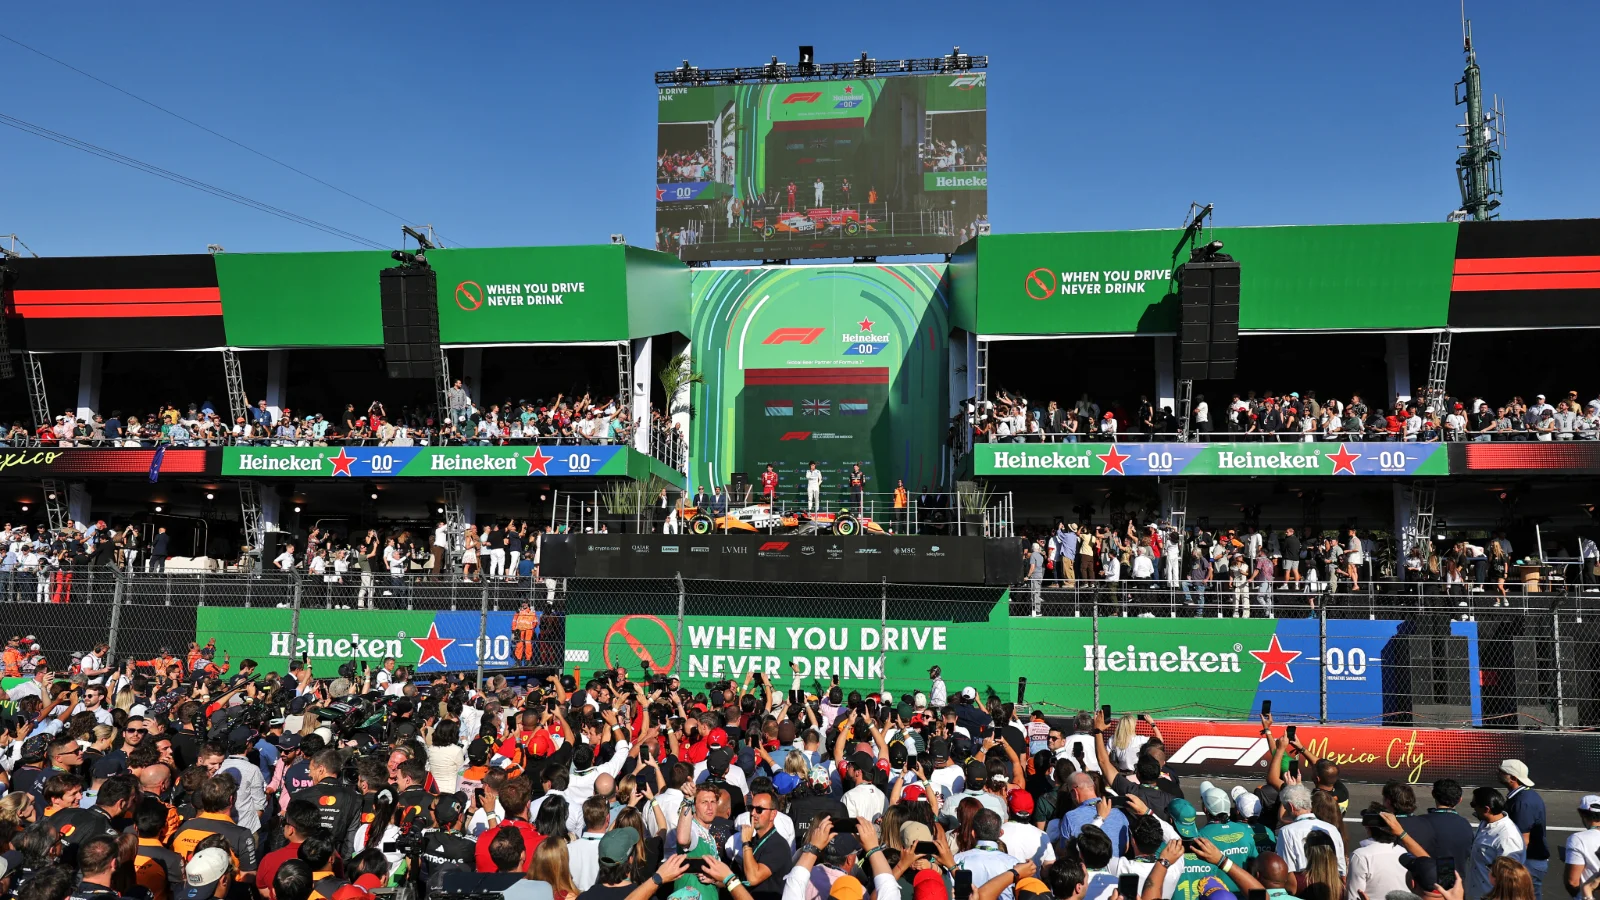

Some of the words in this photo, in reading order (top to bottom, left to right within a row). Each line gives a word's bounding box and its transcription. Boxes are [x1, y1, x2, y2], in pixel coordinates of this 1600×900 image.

[665, 87, 688, 95] DRIVE
[676, 187, 691, 198] 0.0
[1061, 271, 1099, 282] WHEN
[1103, 270, 1130, 281] YOU
[1134, 269, 1171, 280] DRIVE
[486, 284, 520, 295] WHEN
[523, 283, 548, 293] YOU
[551, 282, 585, 293] DRIVE
[1061, 284, 1101, 295] NEVER
[1105, 282, 1145, 294] DRINK
[488, 295, 524, 306] NEVER
[527, 294, 563, 305] DRINK
[842, 333, 890, 343] Heineken
[239, 453, 322, 471] Heineken
[371, 454, 393, 471] 0.0
[431, 453, 517, 470] Heineken
[568, 453, 590, 470] 0.0
[994, 451, 1091, 469] Heineken
[1148, 452, 1172, 469] 0.0
[1218, 450, 1319, 469] Heineken
[1380, 451, 1405, 468] 0.0
[721, 546, 747, 554] LVMH
[687, 625, 776, 650] WHEN
[786, 626, 848, 650] YOU
[861, 627, 947, 651] DRIVE
[269, 632, 404, 658] Heineken
[475, 635, 510, 660] 0.0
[1083, 644, 1242, 673] Heineken
[1326, 647, 1366, 675] 0.0
[688, 656, 782, 680] NEVER
[792, 656, 887, 681] DRINK
[1305, 737, 1380, 768] Mexico
[1386, 730, 1431, 784] City
[1183, 864, 1211, 874] ramco
